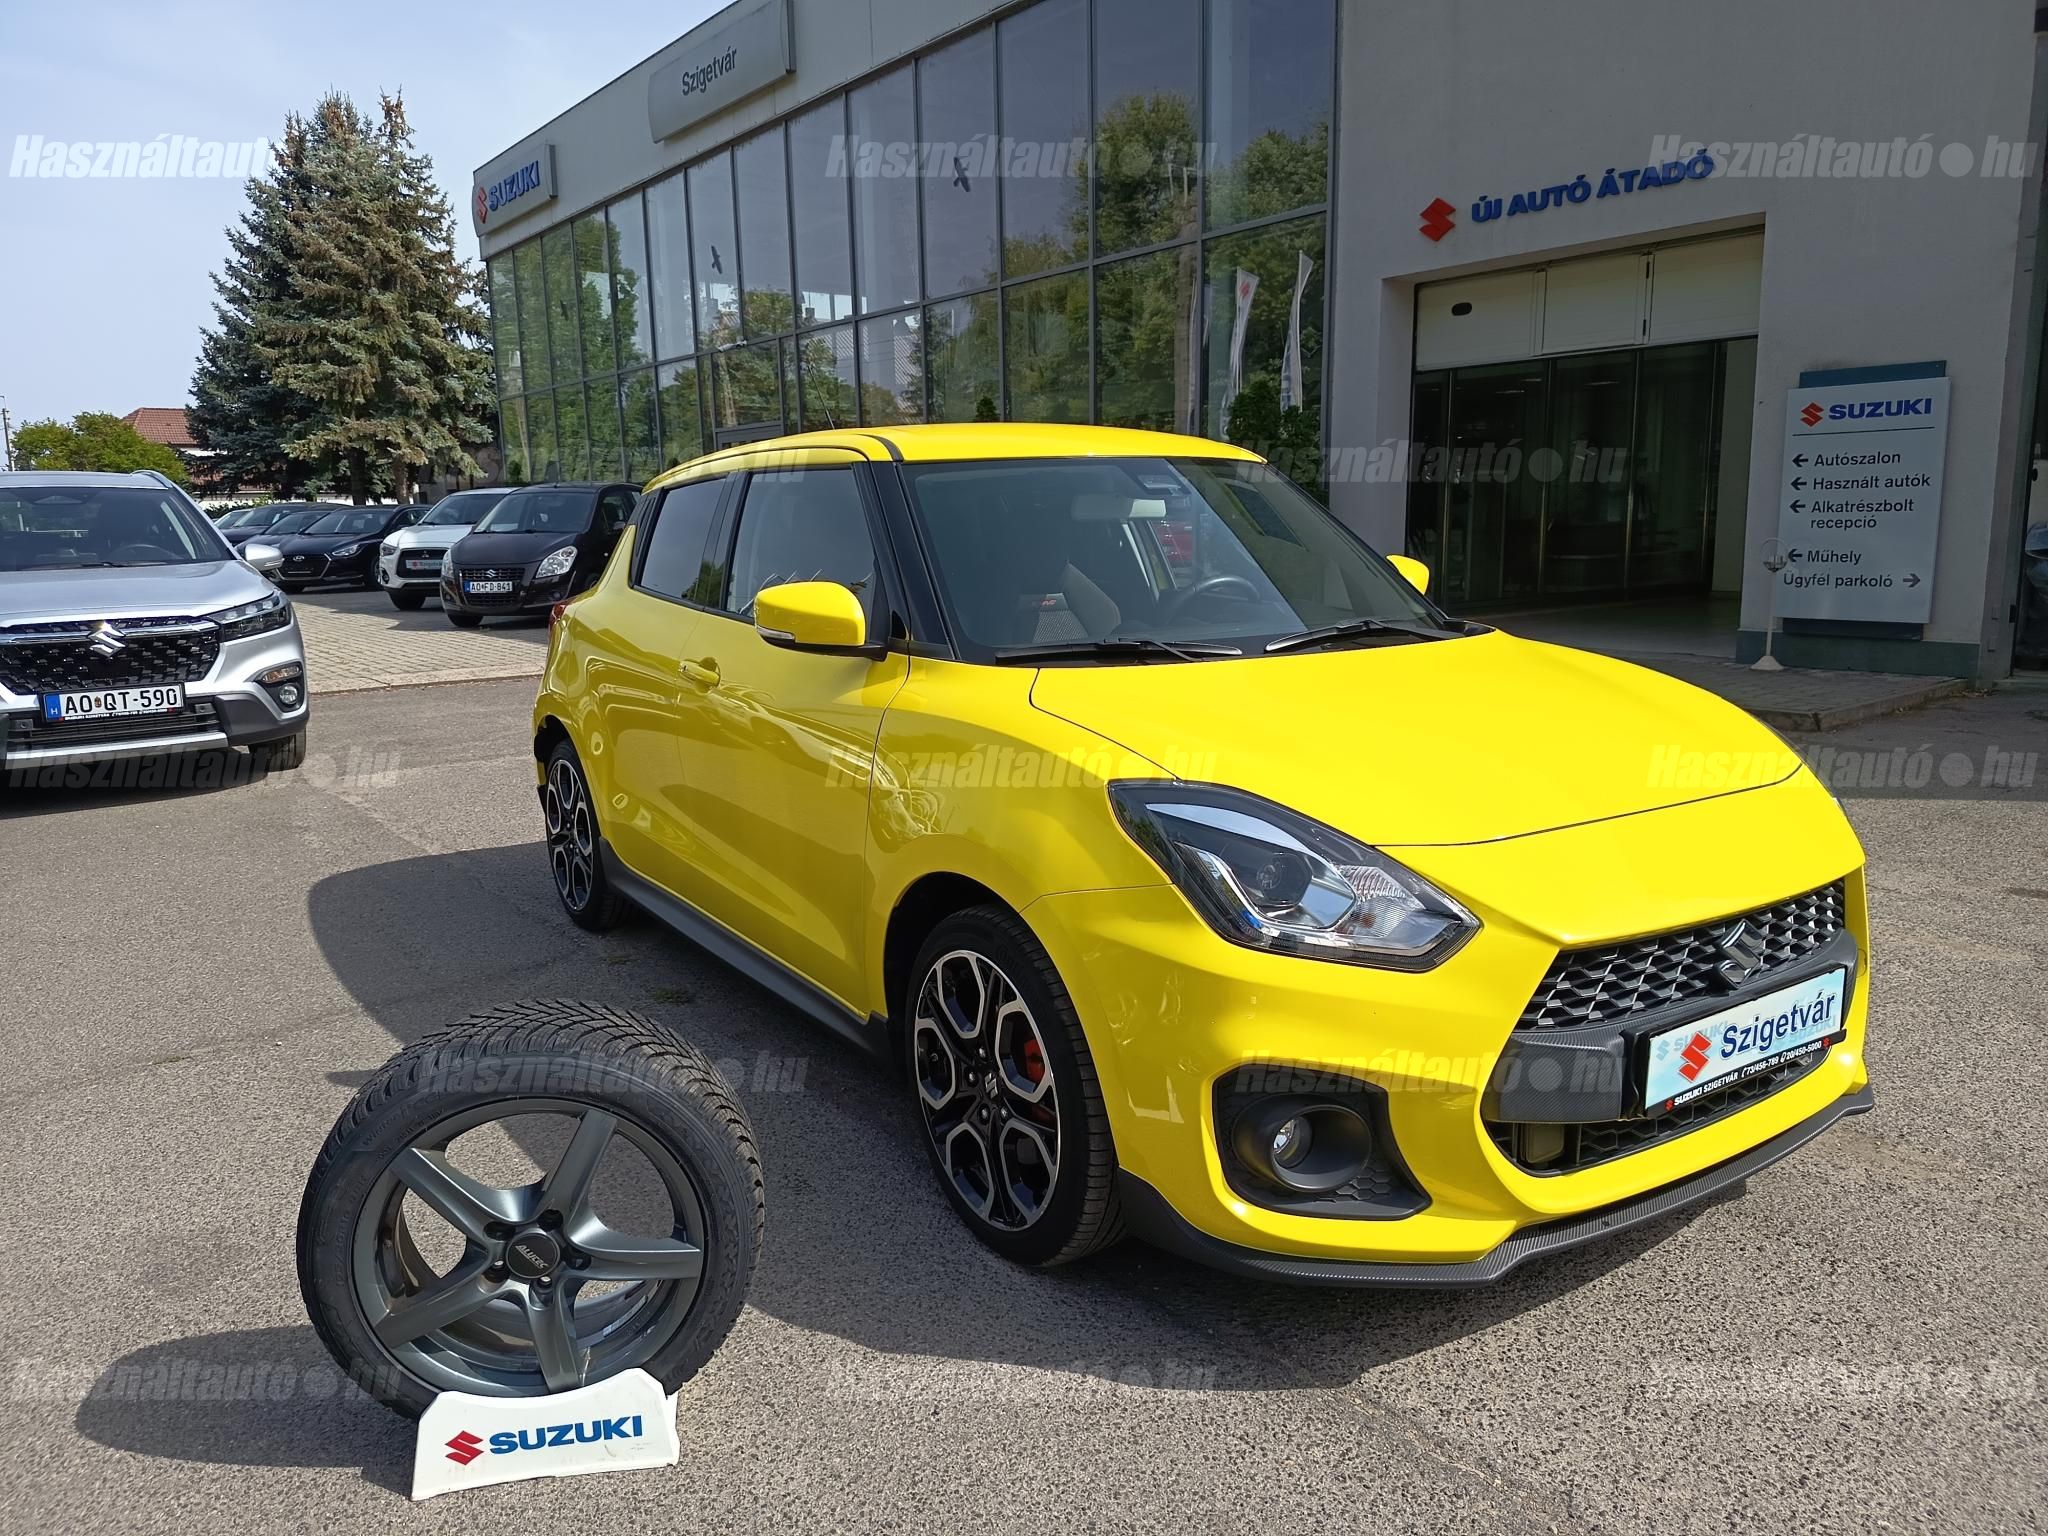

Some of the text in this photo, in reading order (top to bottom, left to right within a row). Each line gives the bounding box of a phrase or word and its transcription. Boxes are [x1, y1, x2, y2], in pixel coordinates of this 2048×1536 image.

[682, 46, 737, 96] Szigetvár
[489, 160, 540, 212] SUZUKI
[1471, 148, 1715, 223] ÚJ AUTÓ ÁTADÓ
[1828, 398, 1932, 420] SUZUKI
[1814, 451, 1901, 467] Autószalon
[1812, 474, 1931, 490] Használt autók
[1811, 499, 1914, 514] Alkatrészbolt
[1810, 515, 1877, 531] recepció
[1807, 549, 1862, 565] Műhely
[1783, 571, 1893, 589] Ügyfél parkoló
[1721, 992, 1835, 1059] Szigetvár
[1674, 1087, 1703, 1105] SUZUKI
[1703, 1071, 1738, 1093] SZIGETVÁR
[514, 1244, 549, 1269] ALUTEC
[489, 1415, 643, 1455] SUZUKI
